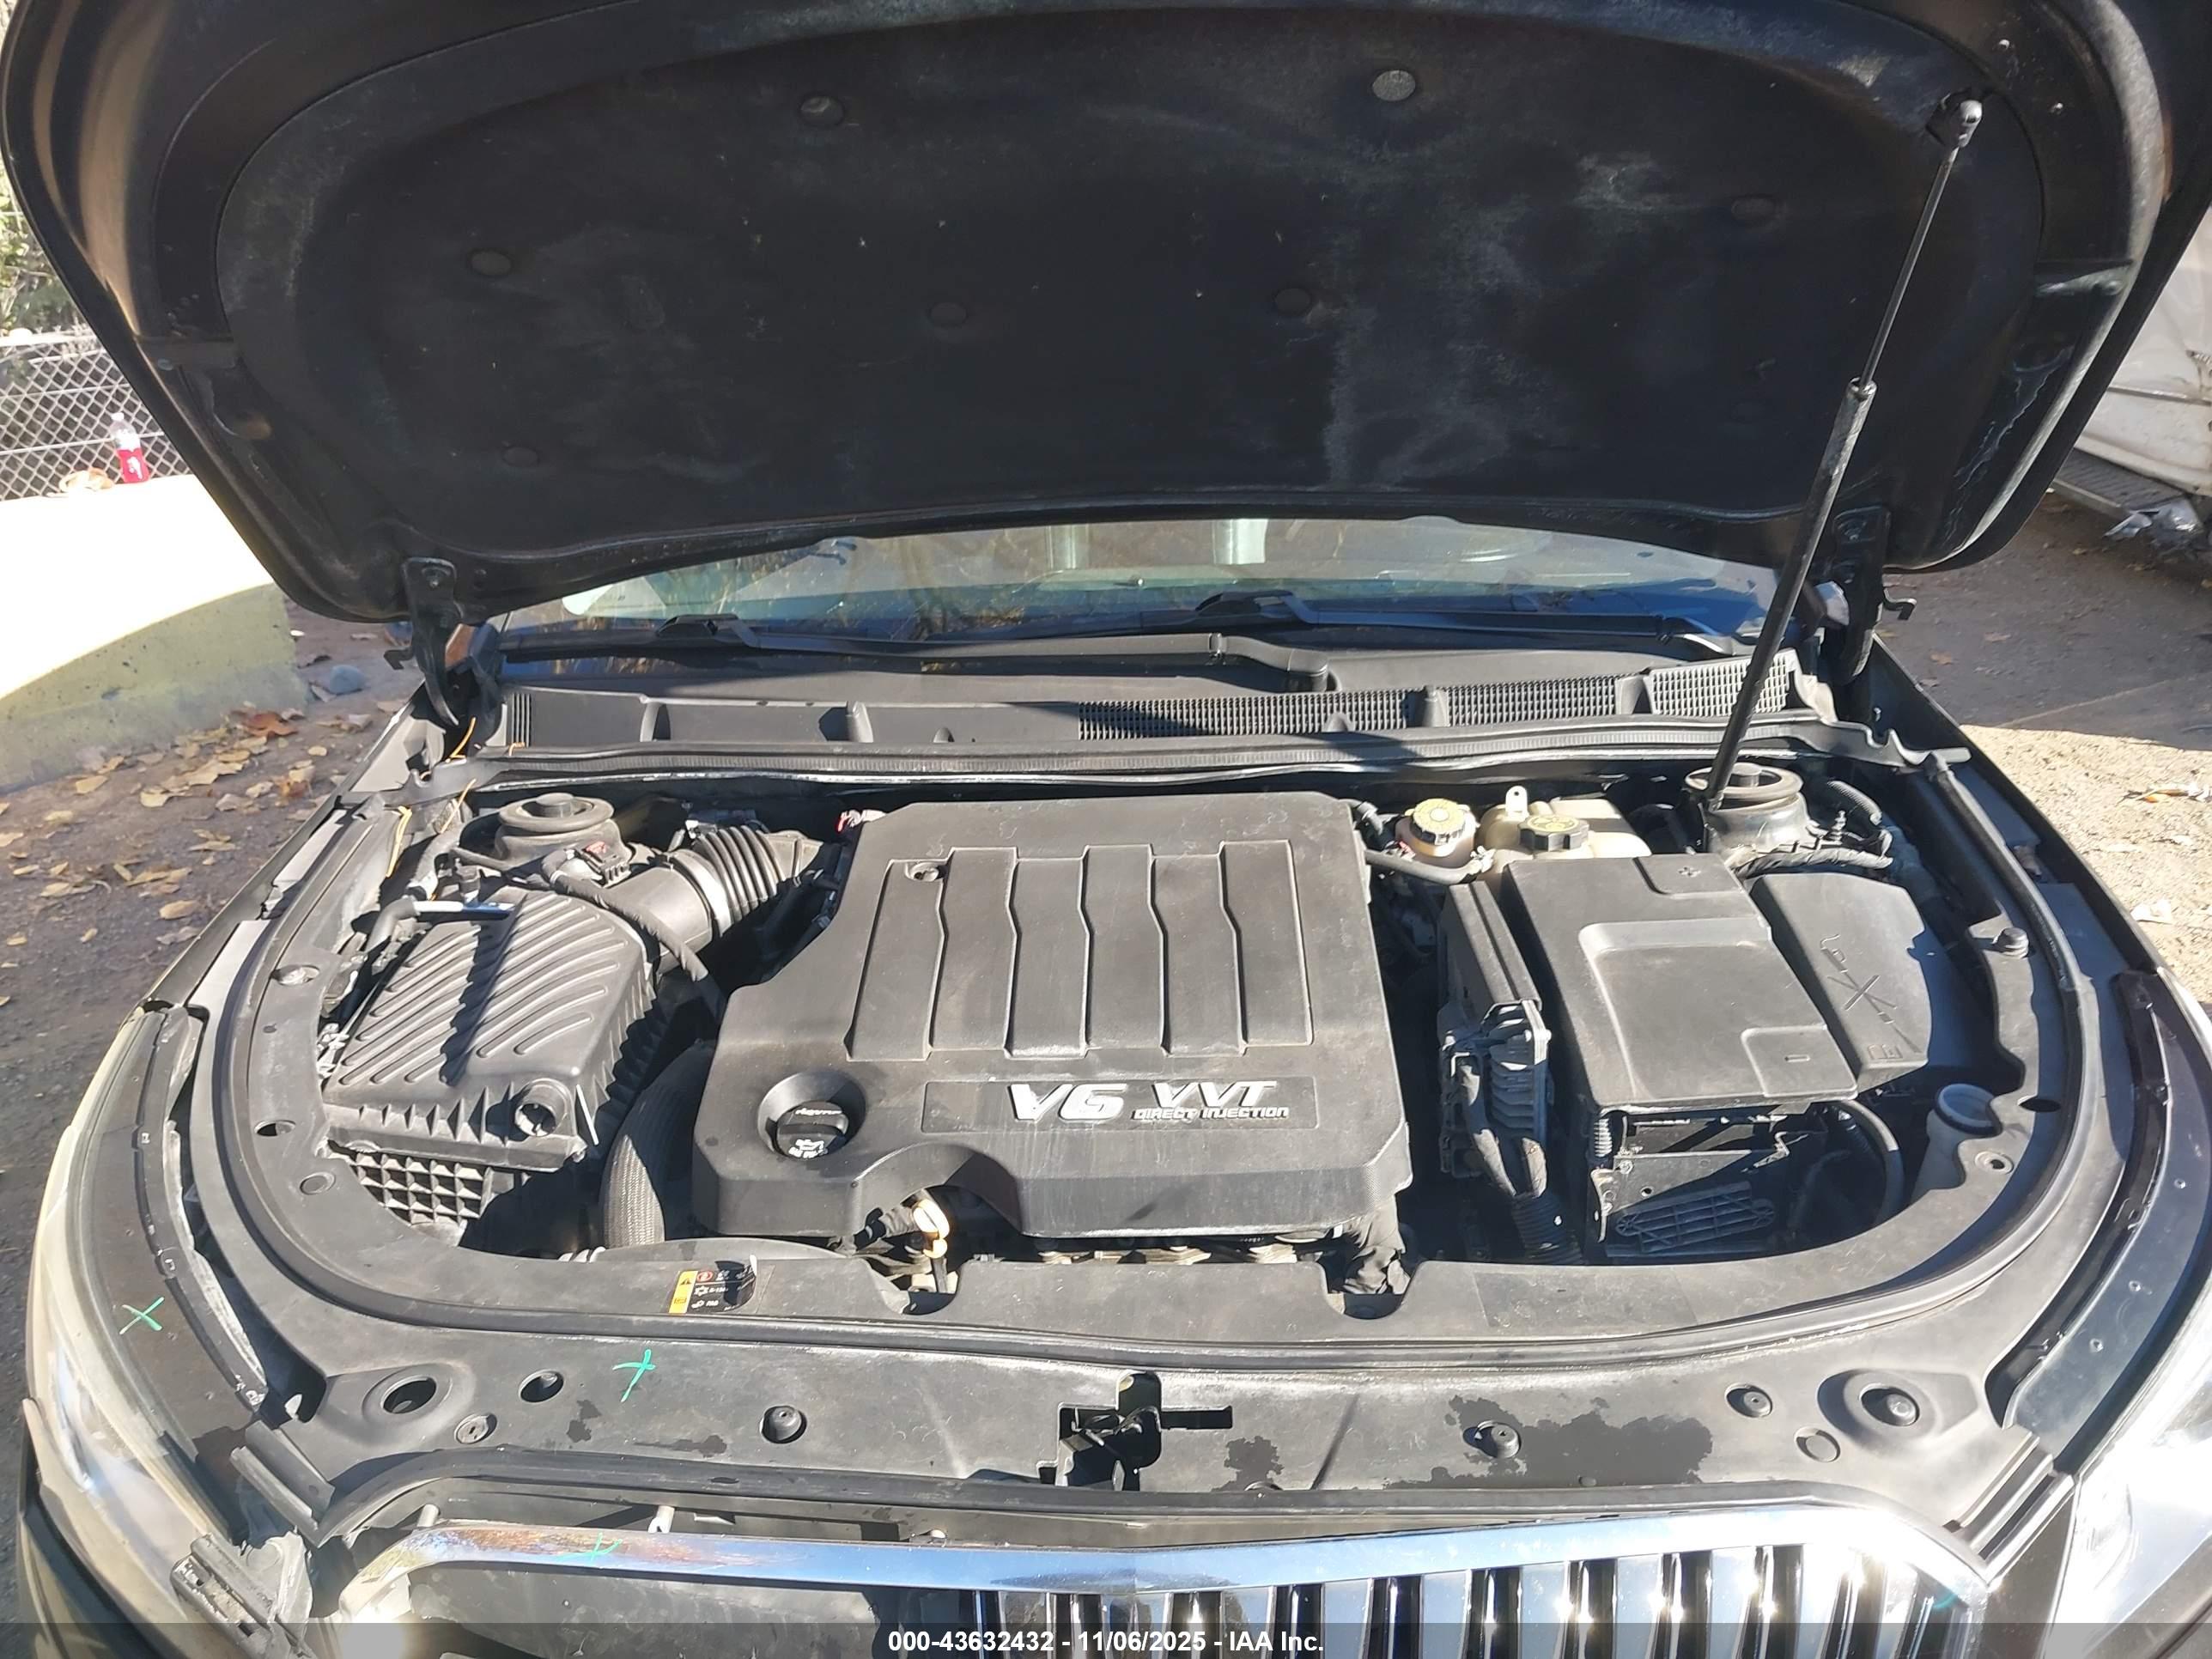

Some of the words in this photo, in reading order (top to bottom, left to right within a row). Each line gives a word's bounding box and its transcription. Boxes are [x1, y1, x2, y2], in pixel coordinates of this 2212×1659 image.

[1007, 1083, 1127, 1122] V6
[1152, 1080, 1278, 1108] VVT
[1131, 1108, 1196, 1120] DIRECT
[1201, 1106, 1289, 1119] INJECTION
